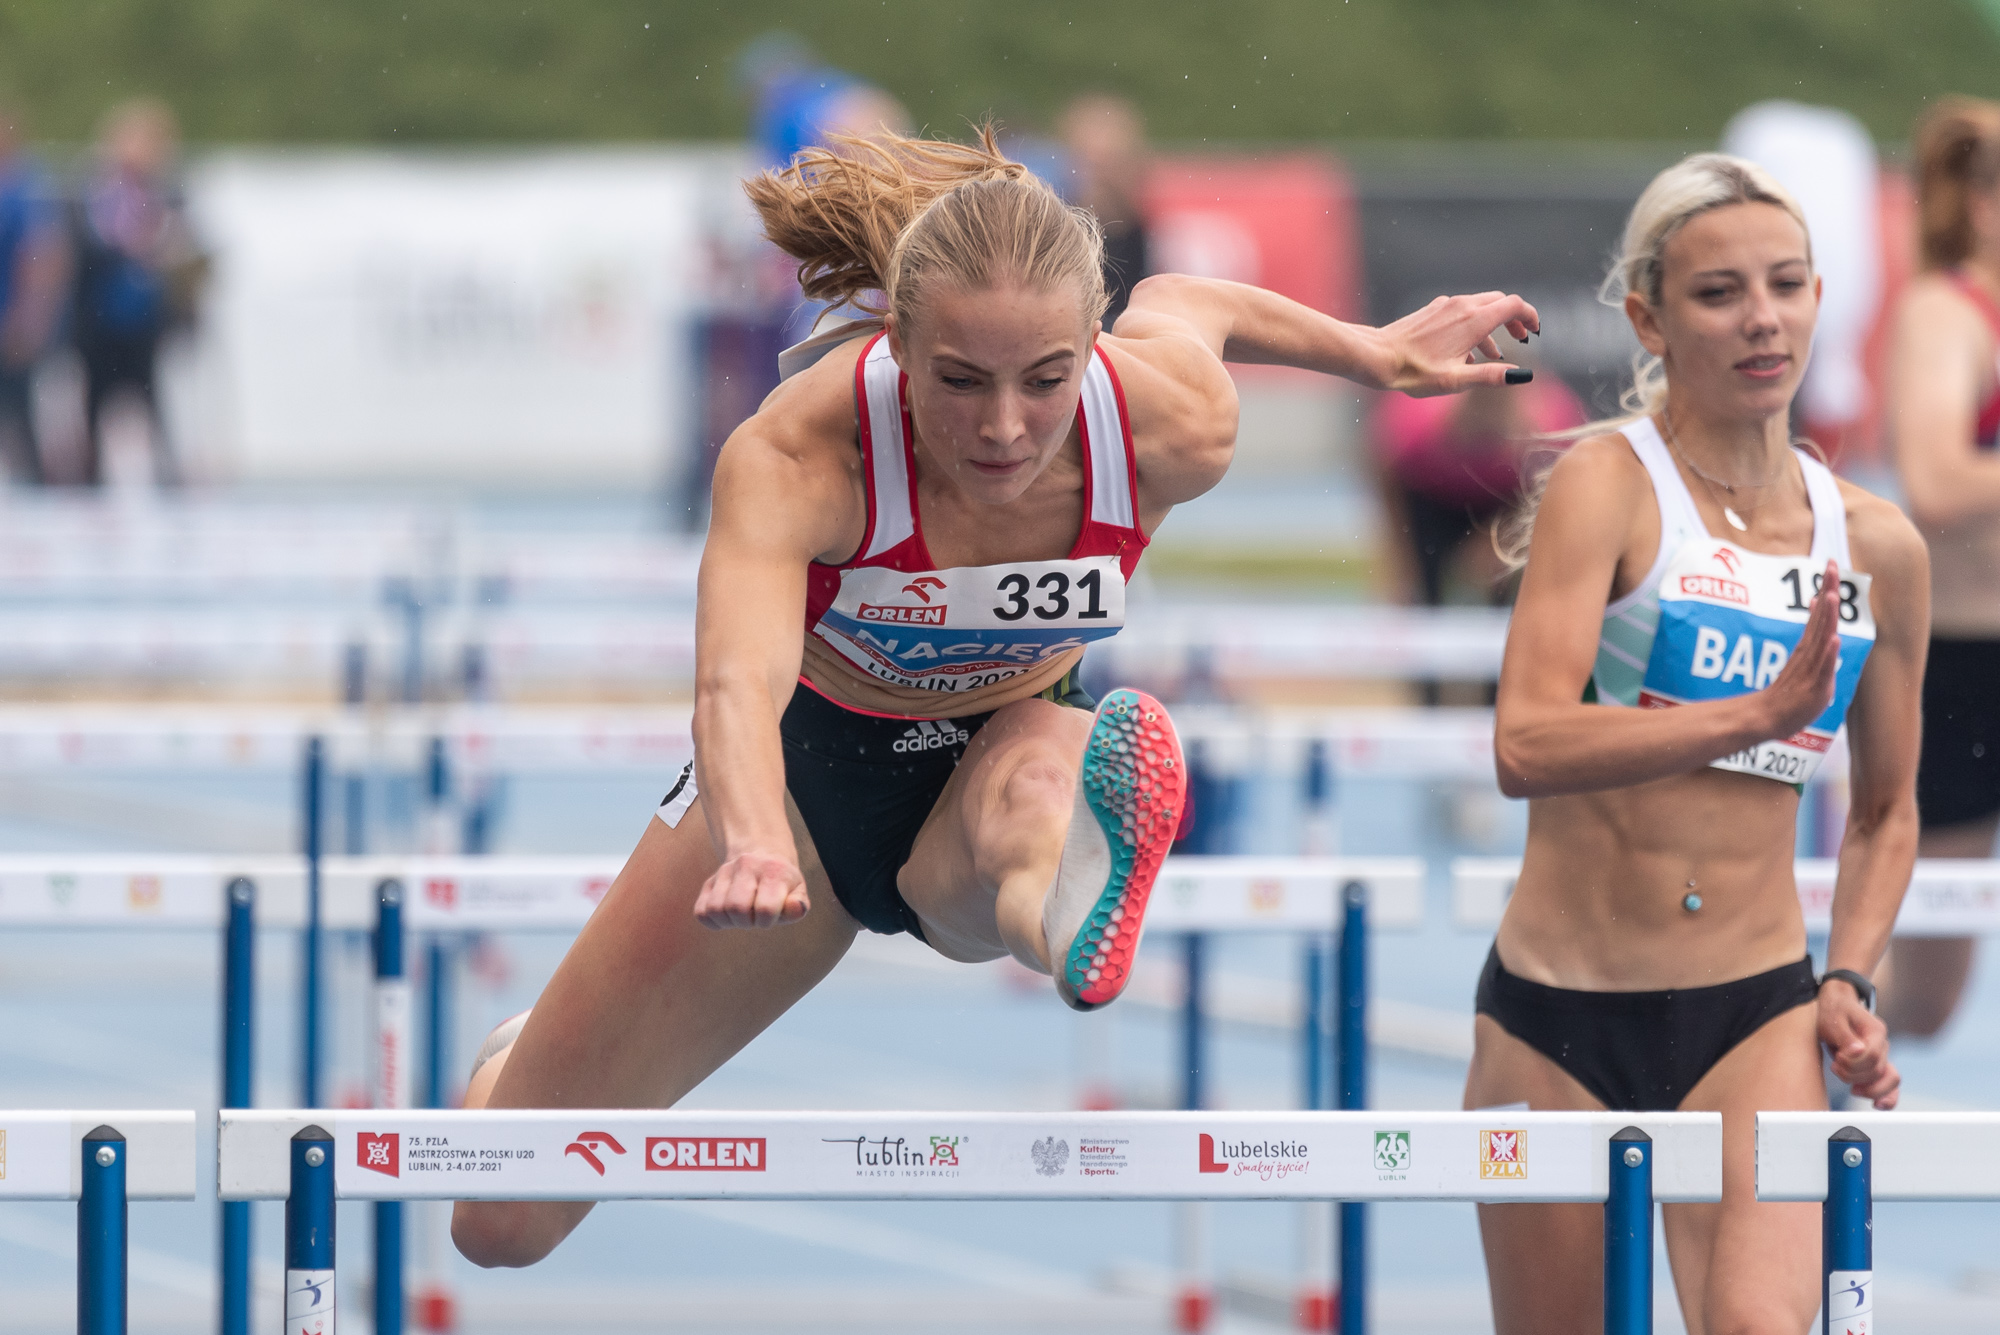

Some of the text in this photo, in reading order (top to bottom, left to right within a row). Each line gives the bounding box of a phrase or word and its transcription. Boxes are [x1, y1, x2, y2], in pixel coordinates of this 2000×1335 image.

[993, 569, 1108, 622] 331
[1682, 577, 1748, 605] ORLEN
[861, 606, 943, 624] ORLEN
[867, 662, 958, 692] LUBLIN
[892, 727, 970, 753] adidas
[1763, 751, 1808, 779] 2021
[408, 1137, 449, 1147] 75. PZLA
[1080, 1146, 1115, 1154] Kultury
[1221, 1140, 1308, 1158] lubelskie
[408, 1150, 535, 1159] MISTRZOSTWA POLSKI U20
[650, 1140, 760, 1168] ORLEN
[408, 1162, 502, 1172] LUBLIN, 2-4.07.2021
[856, 1170, 961, 1178] MIASTO INSPIRACJI
[1233, 1161, 1310, 1181] Smakuj życie!
[1482, 1163, 1526, 1177] PZLA
